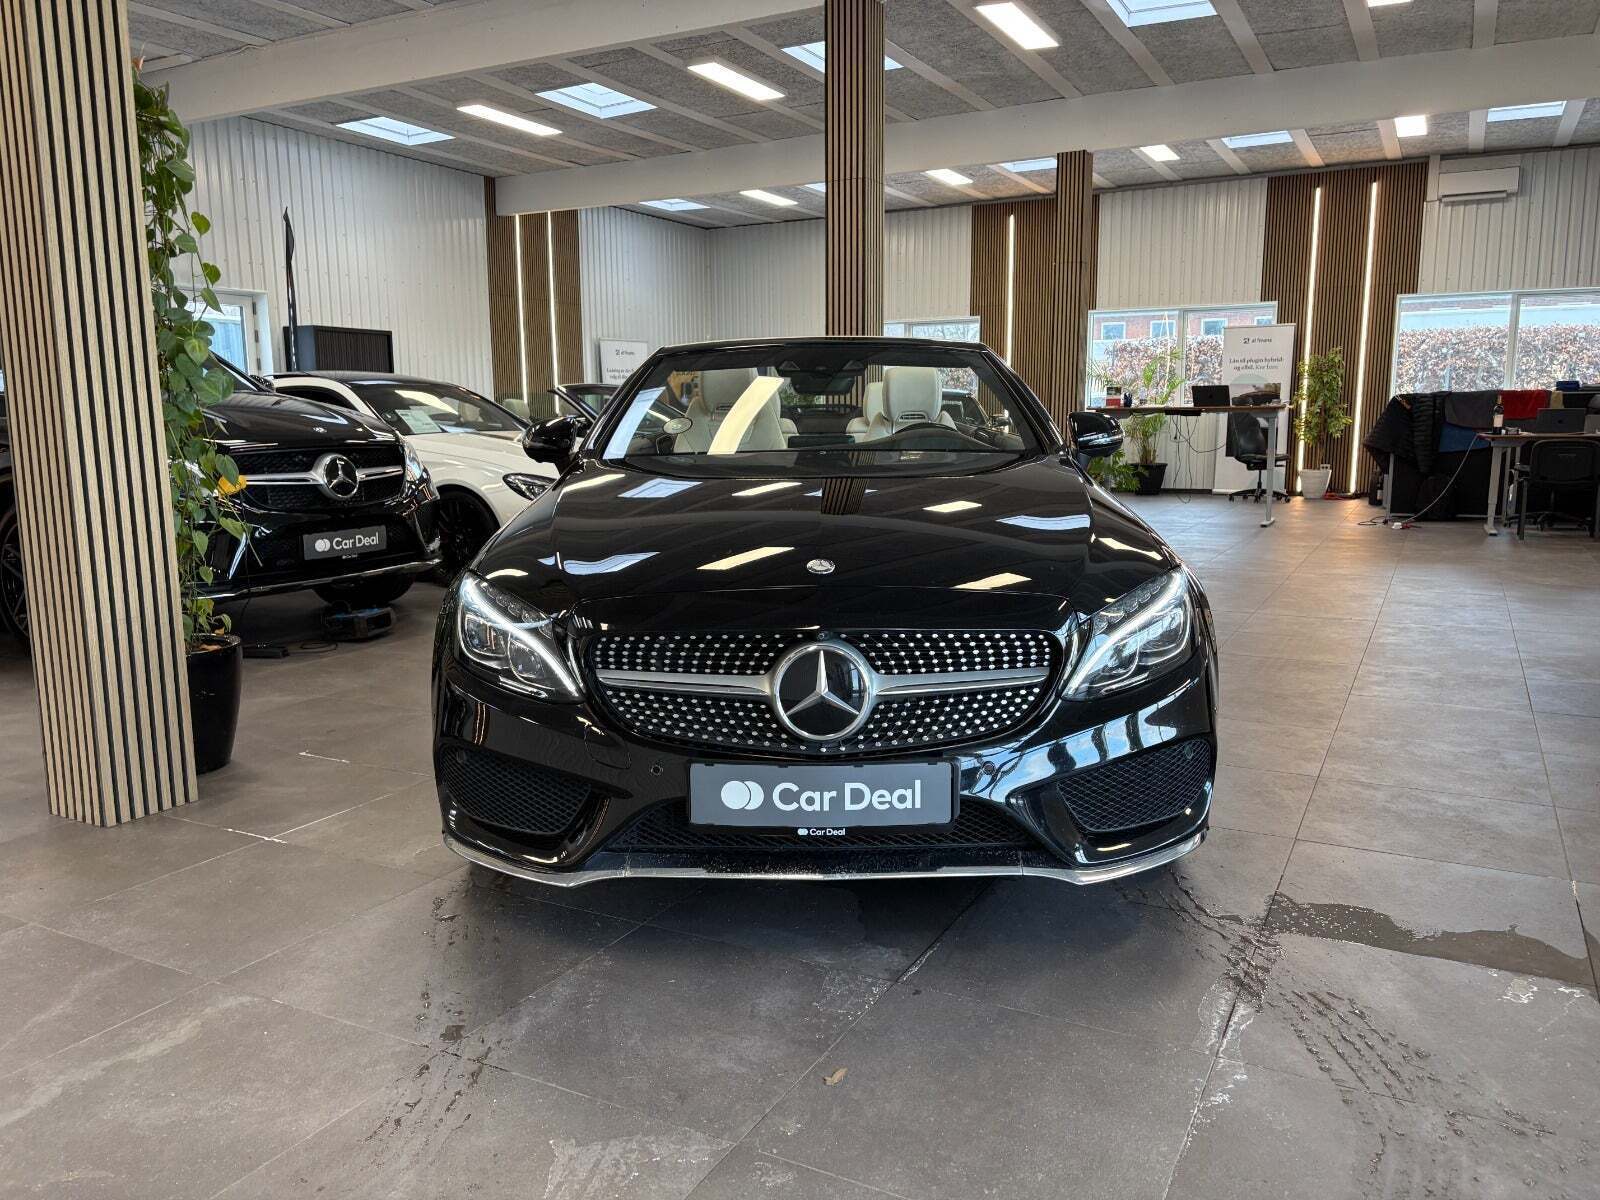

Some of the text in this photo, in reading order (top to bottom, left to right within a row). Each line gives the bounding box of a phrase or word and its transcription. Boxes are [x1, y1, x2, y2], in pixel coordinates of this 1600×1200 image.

[333, 531, 379, 550] Car Deal
[772, 779, 921, 812] Car Deal
[809, 827, 846, 836] Car Deal
